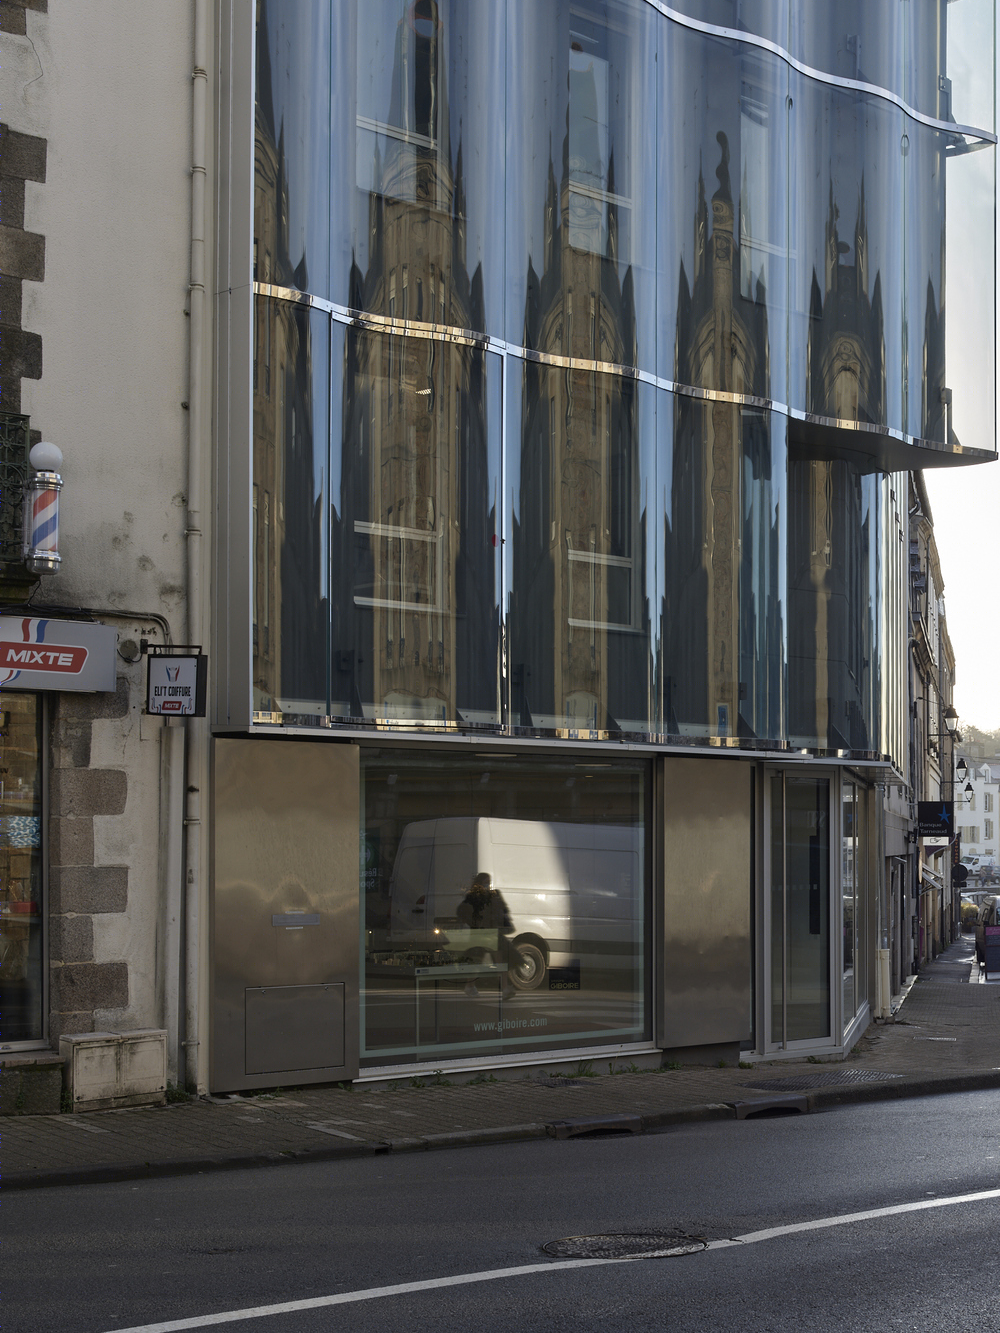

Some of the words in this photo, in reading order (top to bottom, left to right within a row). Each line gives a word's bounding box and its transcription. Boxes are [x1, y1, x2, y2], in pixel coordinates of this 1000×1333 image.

[6, 649, 74, 666] MIXTE
[168, 686, 191, 696] COIFFURE
[473, 1017, 548, 1033] www.giboire.com
